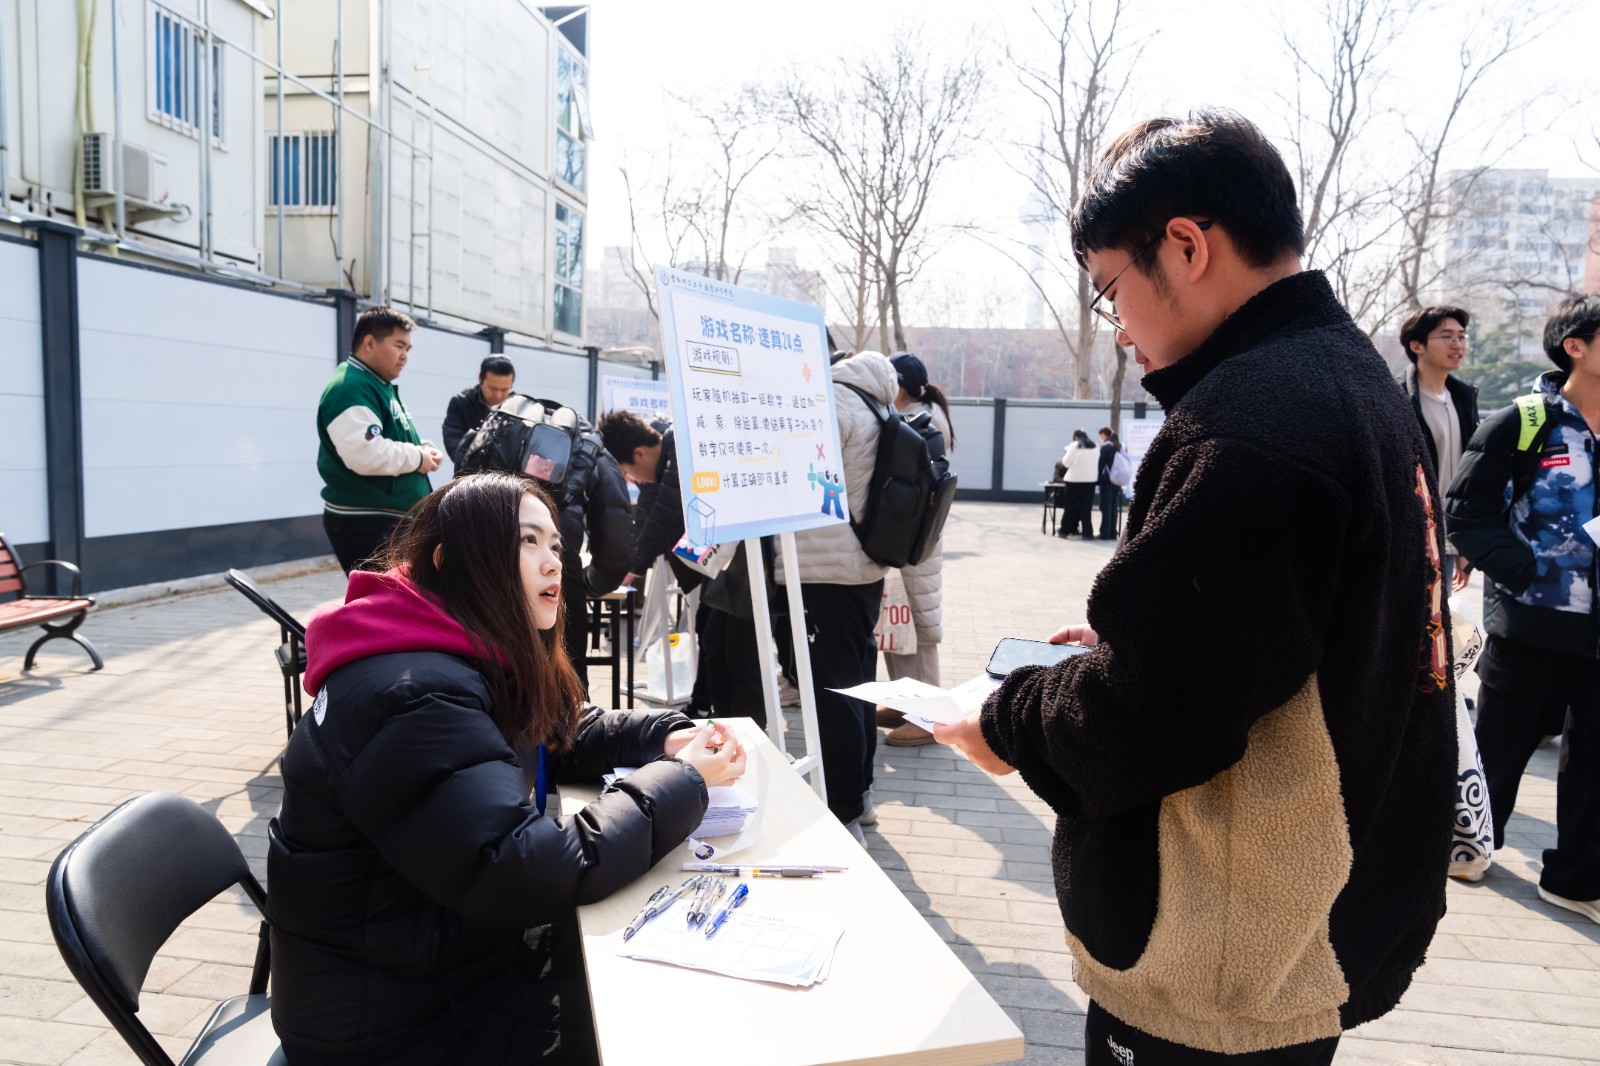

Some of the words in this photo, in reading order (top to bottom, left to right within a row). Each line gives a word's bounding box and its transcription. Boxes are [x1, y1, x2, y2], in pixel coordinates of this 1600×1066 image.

[1527, 405, 1540, 427] MAX
[1542, 459, 1568, 467] CHINA
[1106, 1034, 1134, 1062] Jeep
